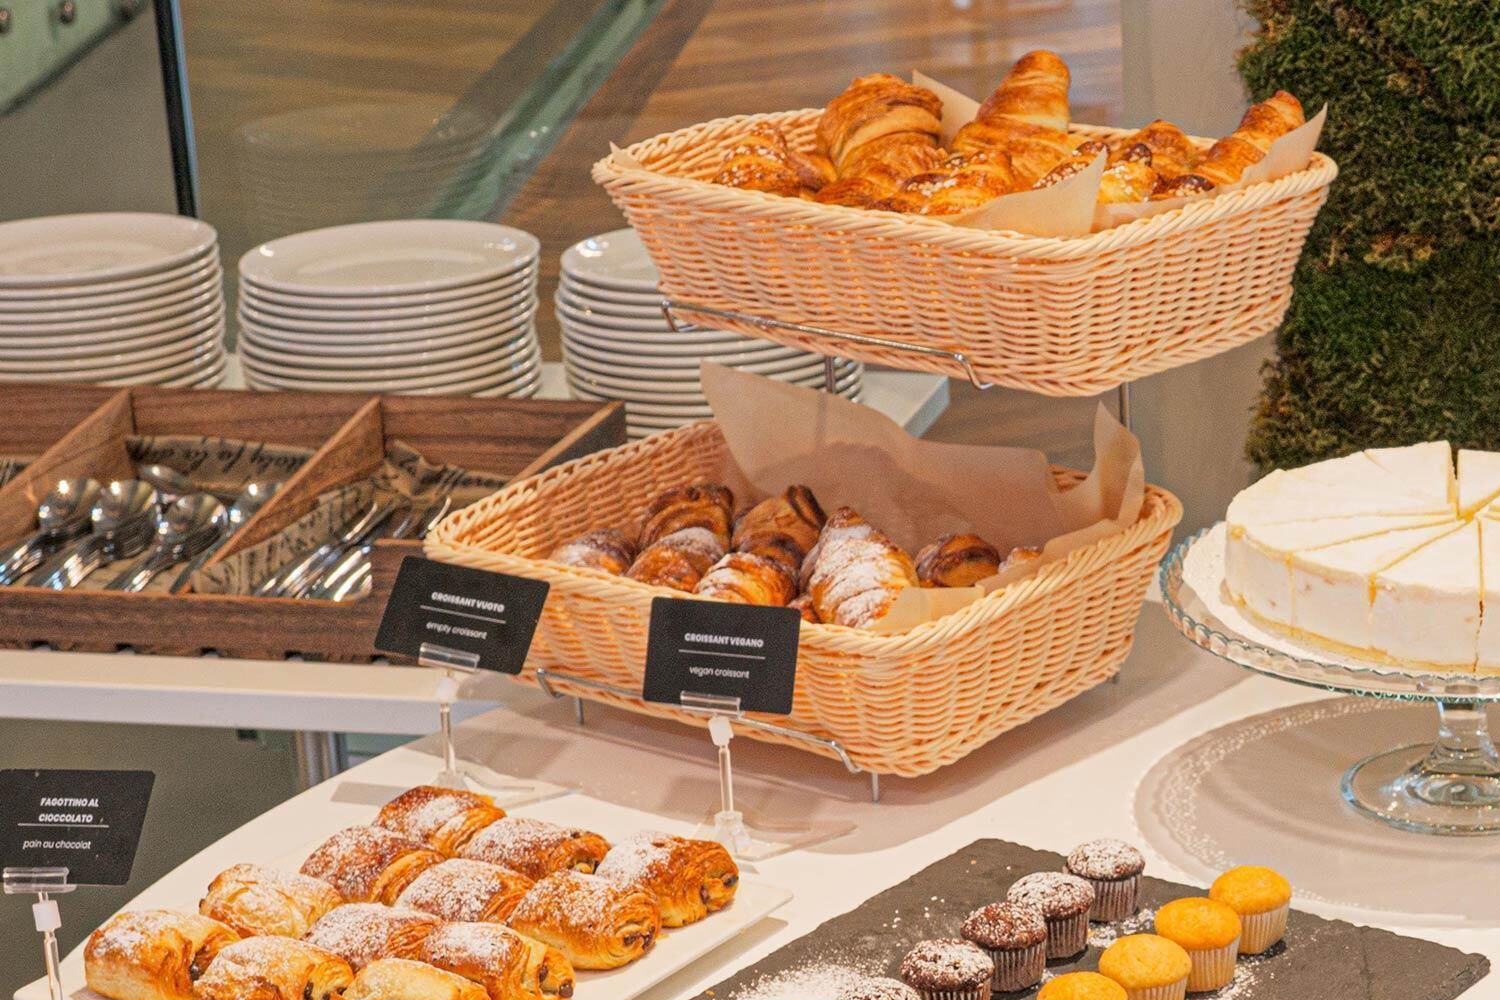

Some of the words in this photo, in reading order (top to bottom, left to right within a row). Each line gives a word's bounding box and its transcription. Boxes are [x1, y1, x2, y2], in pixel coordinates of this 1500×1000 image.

[476, 599, 505, 613] VUOTO
[426, 621, 451, 634] empty
[452, 626, 488, 640] croissant
[684, 632, 730, 645] CROISSANT
[729, 636, 764, 648] VEGANO
[689, 666, 714, 677] vegan
[714, 668, 750, 679] croissant
[40, 797, 88, 808] FAGOTTINO
[88, 797, 99, 808] AL
[38, 813, 94, 823] CIOCCOLATO
[22, 839, 42, 850] pain
[43, 840, 53, 849] au
[55, 839, 92, 850] chocolat
